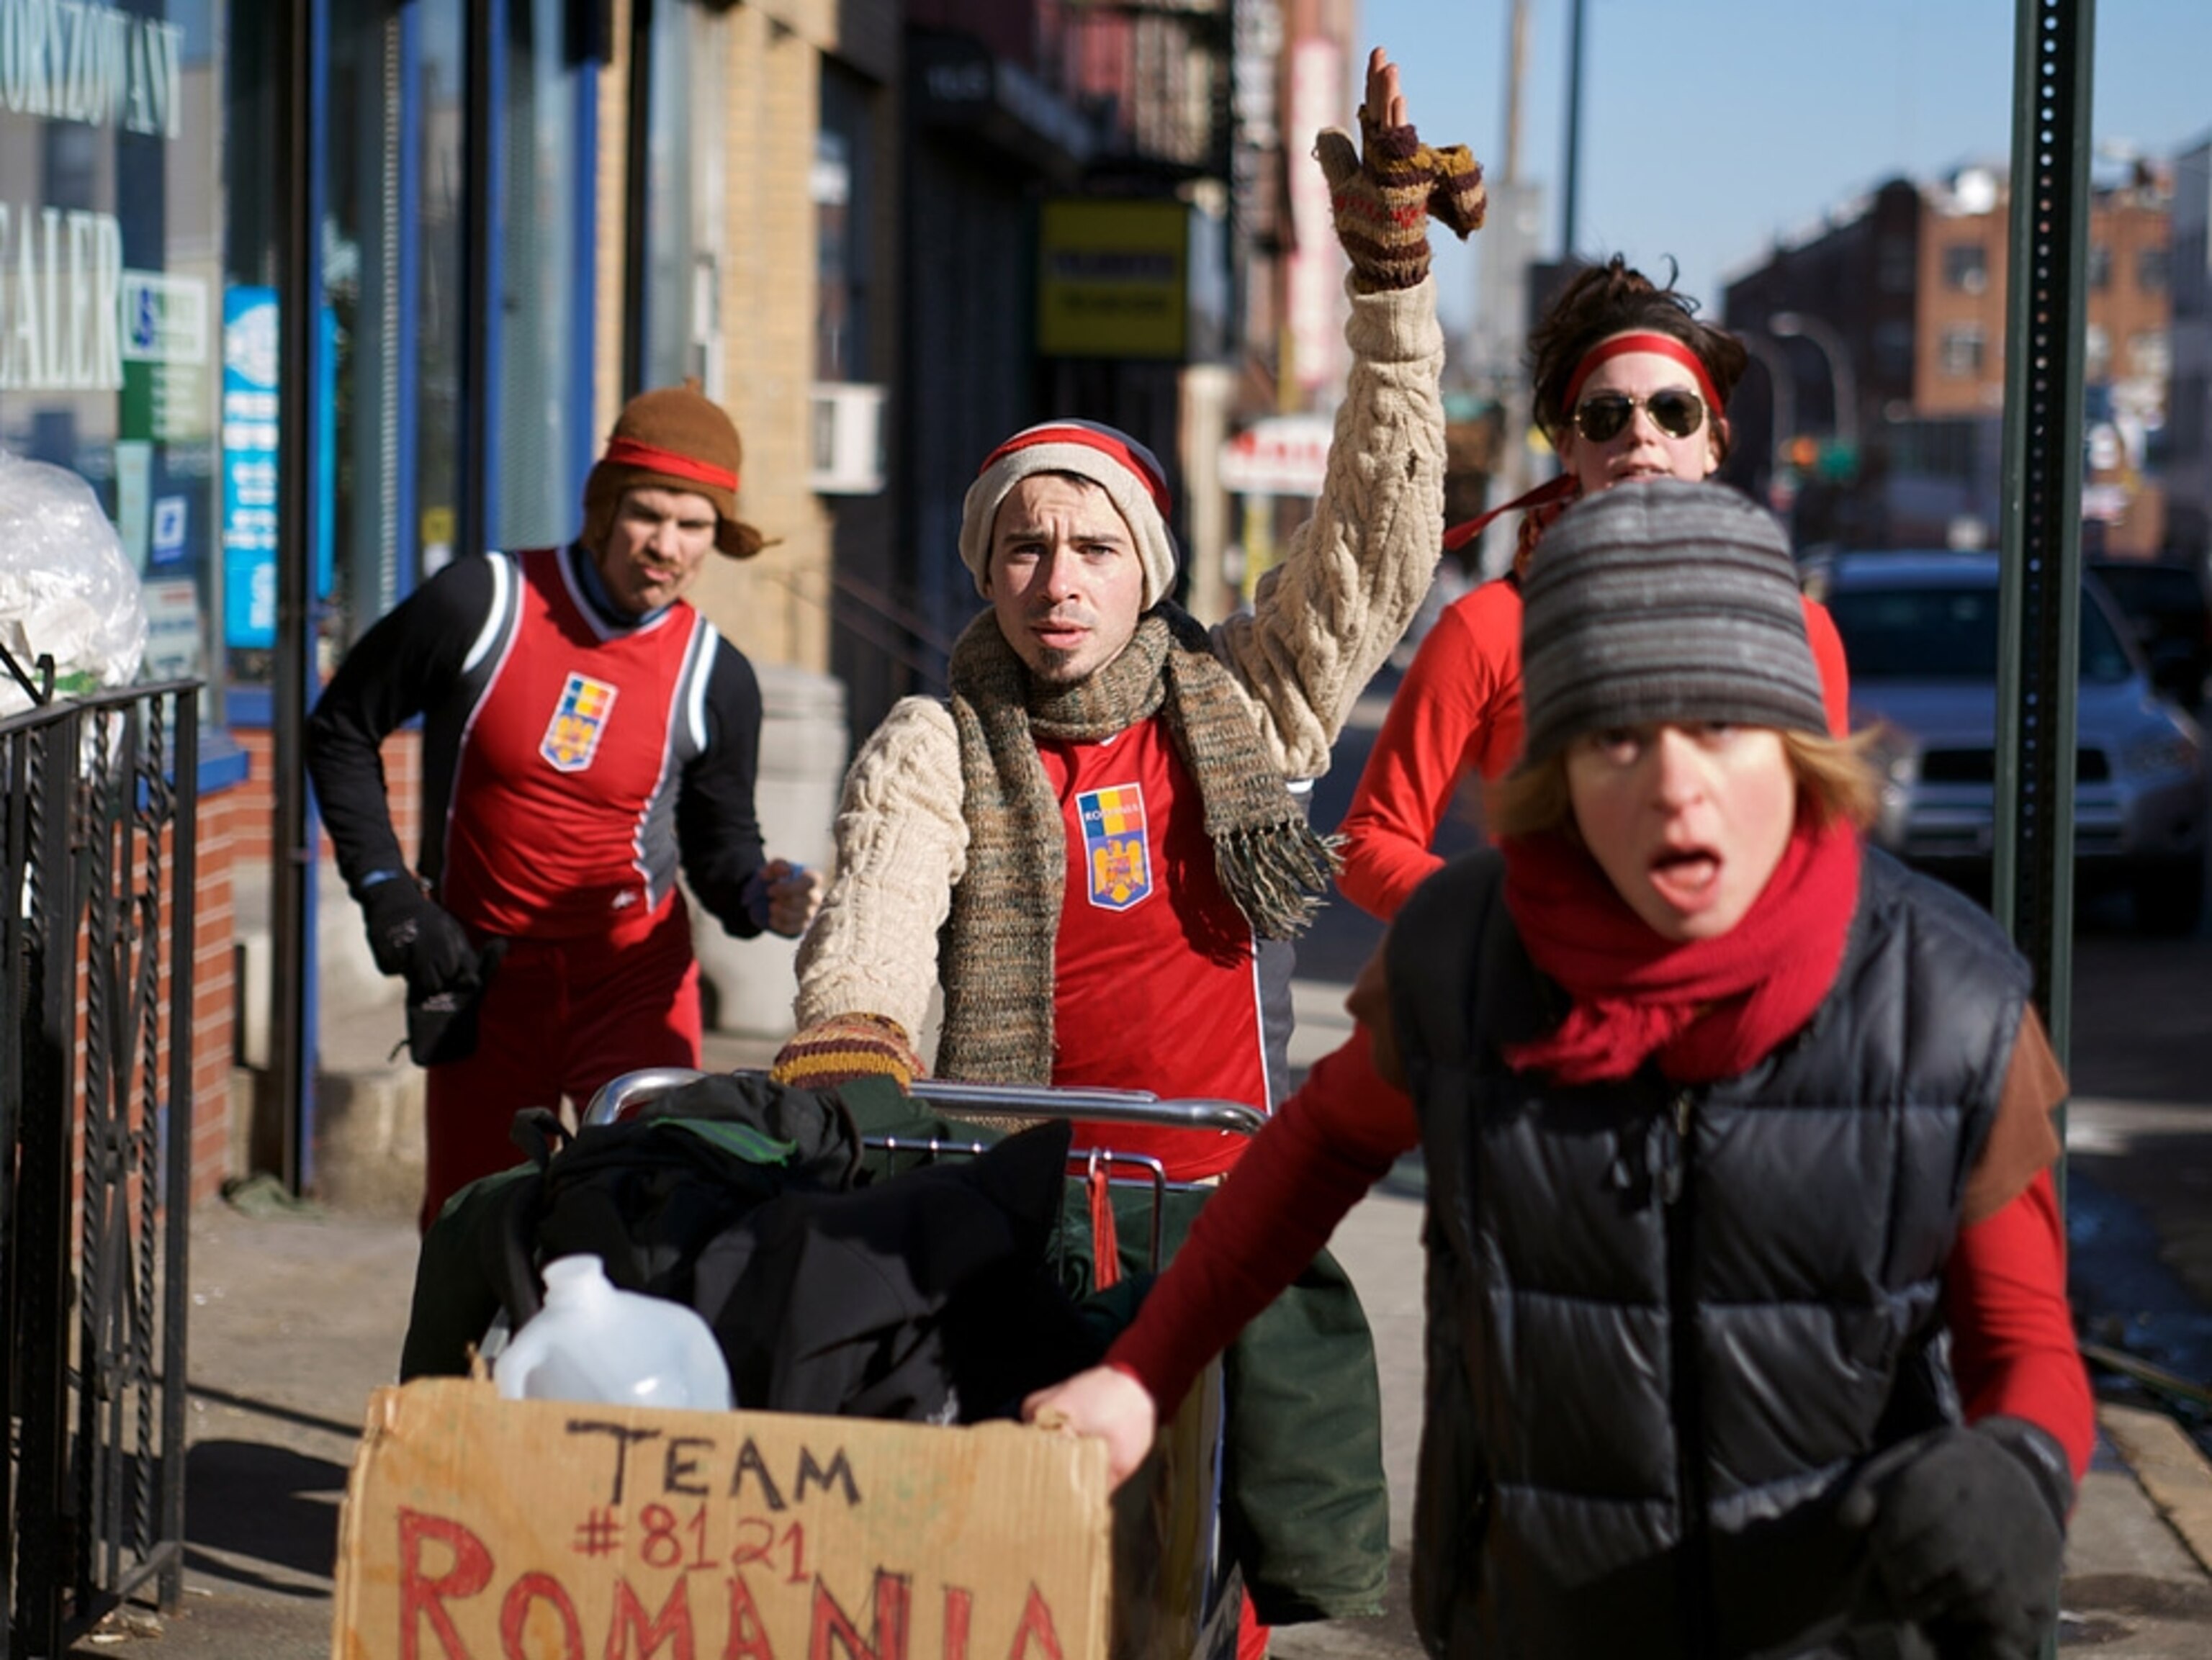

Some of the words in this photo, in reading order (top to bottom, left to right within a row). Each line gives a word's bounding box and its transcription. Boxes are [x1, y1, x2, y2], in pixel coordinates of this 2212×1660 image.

[566, 1420, 861, 1511] TEAM
[397, 1505, 1065, 1660] ROMANIA
[572, 1502, 810, 1583] #8121
